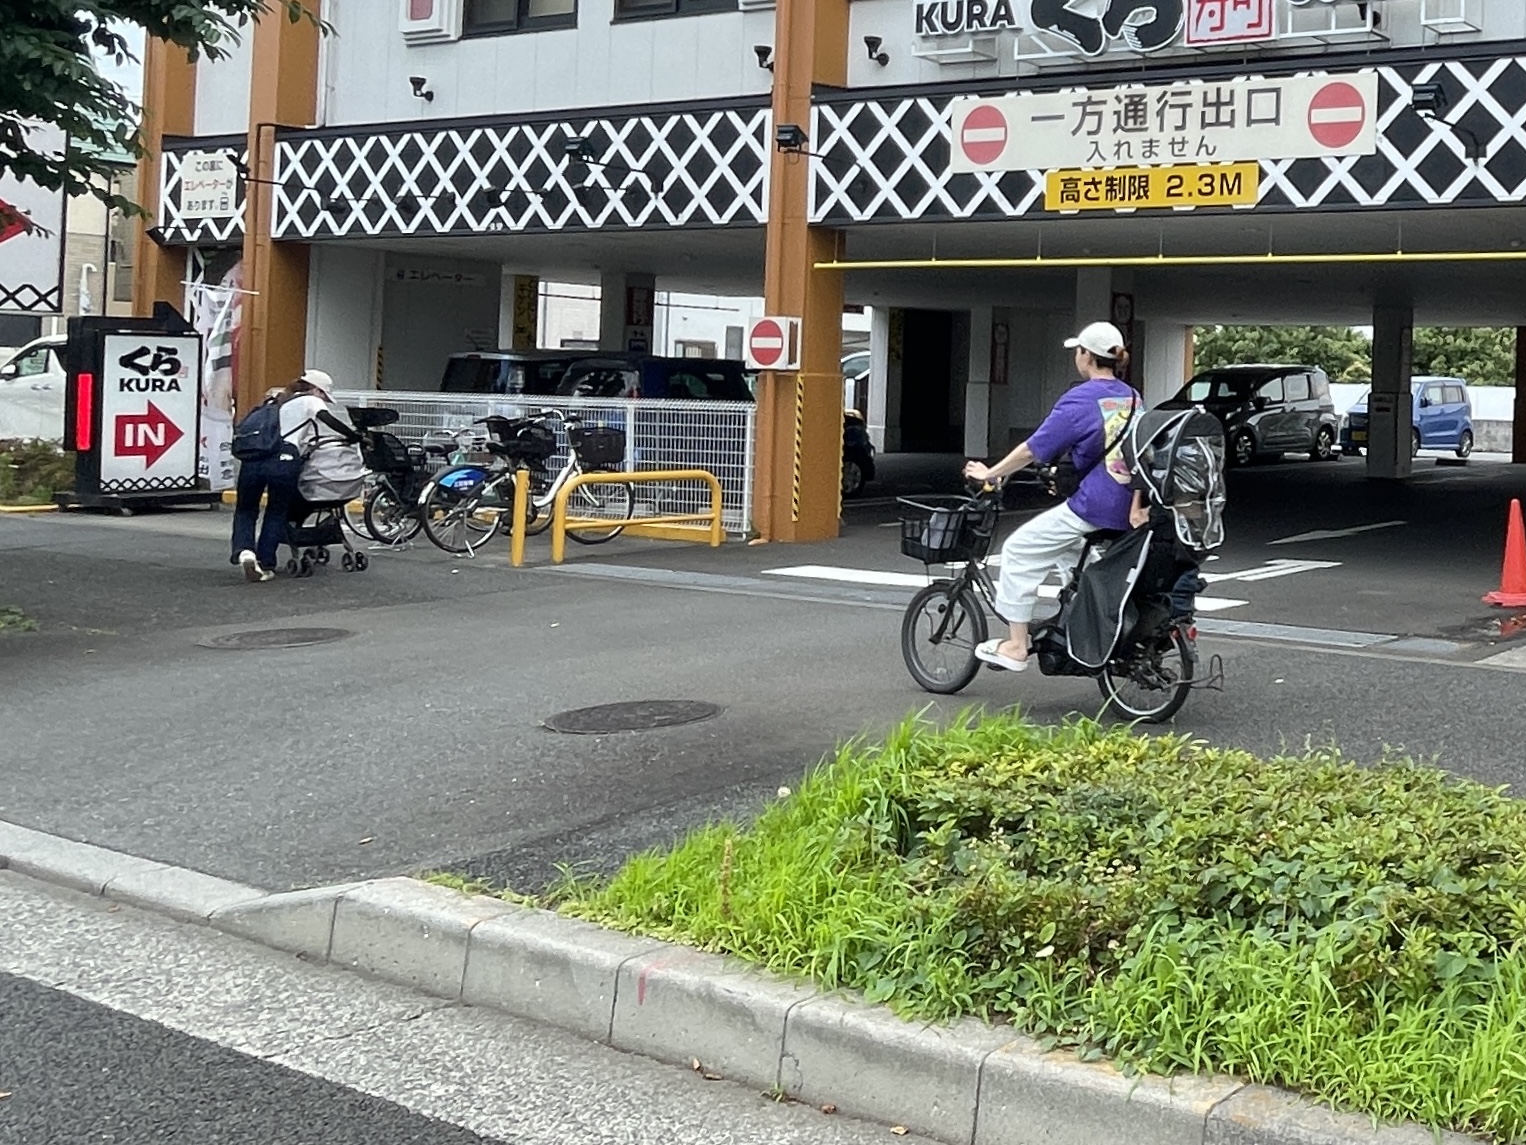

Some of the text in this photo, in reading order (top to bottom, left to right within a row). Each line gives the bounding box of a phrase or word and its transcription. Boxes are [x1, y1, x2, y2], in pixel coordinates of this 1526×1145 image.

[1031, 86, 1283, 137] 一方通行出口
[1086, 135, 1218, 164] 入れません
[1060, 172, 1243, 204] 高さ制限 2.3M
[119, 346, 181, 376] くら
[120, 378, 182, 392] KURA
[124, 423, 165, 447] IN
